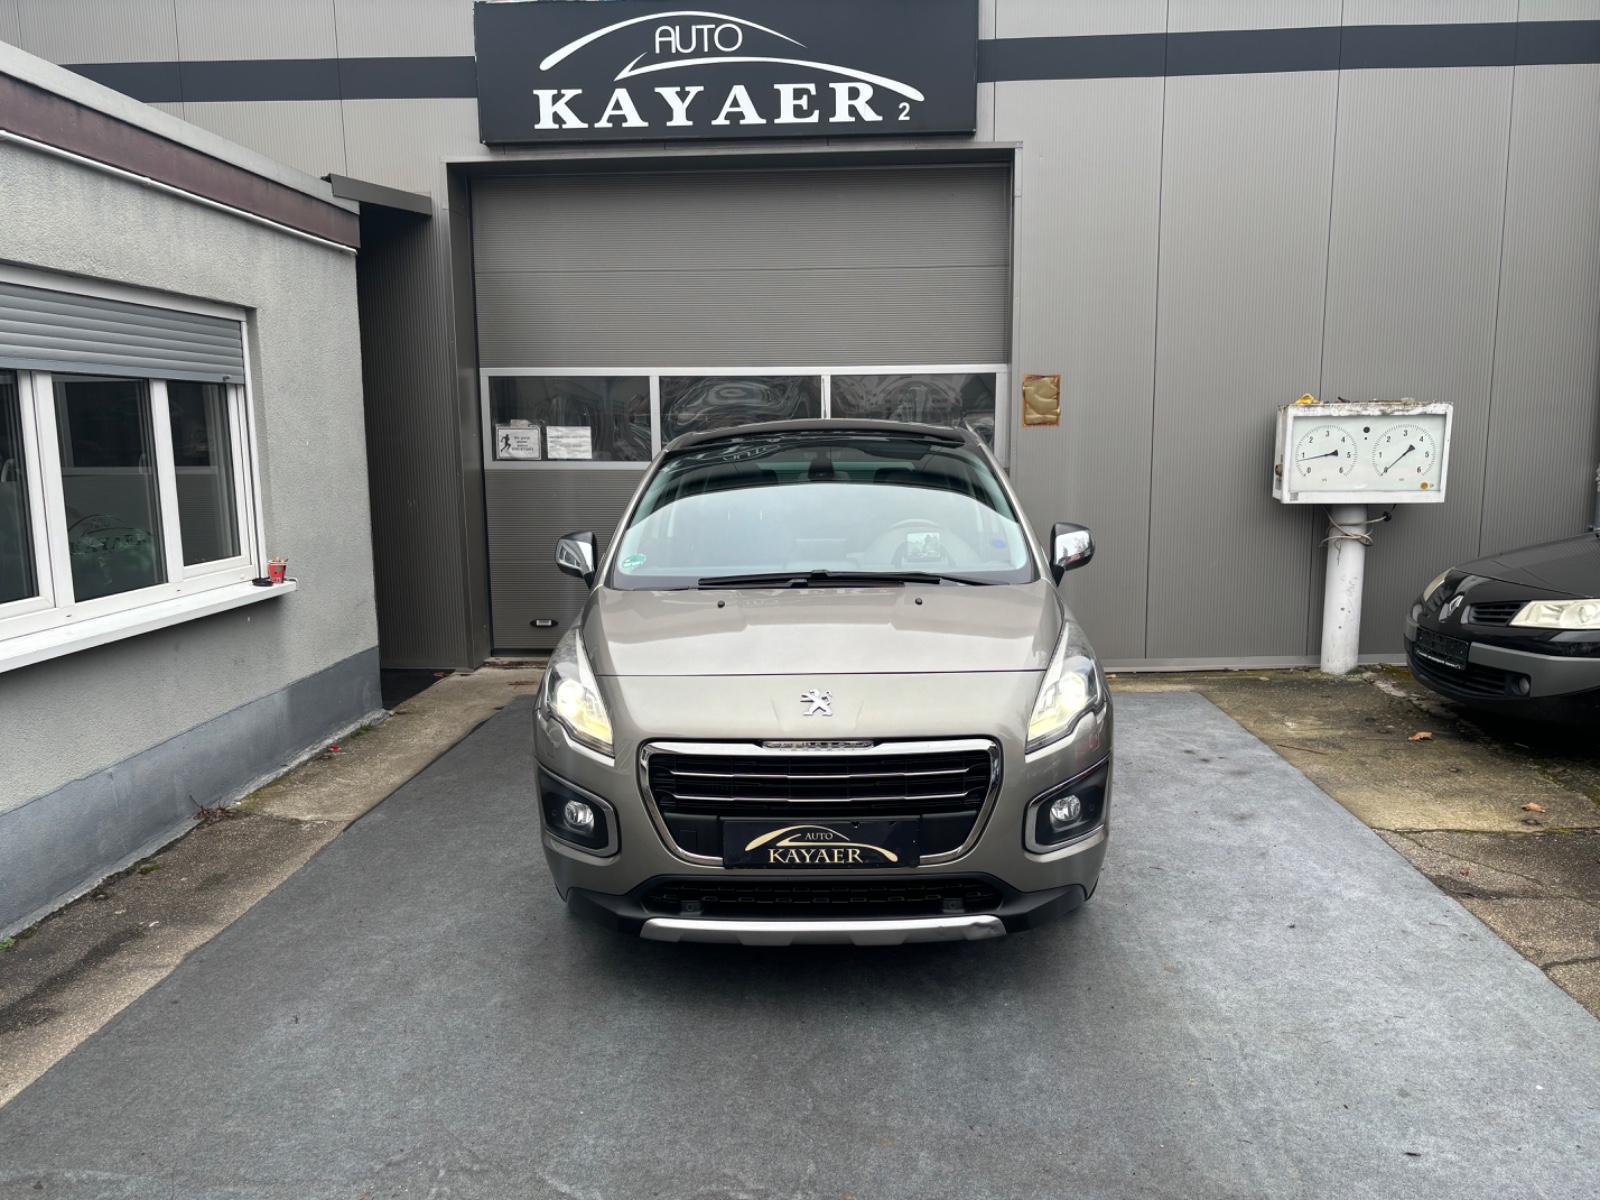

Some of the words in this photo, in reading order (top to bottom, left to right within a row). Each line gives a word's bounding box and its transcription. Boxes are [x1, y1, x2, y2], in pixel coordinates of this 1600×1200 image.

[655, 24, 743, 54] AUTO
[533, 82, 883, 130] KAYAER
[898, 102, 911, 121] 2
[805, 832, 834, 841] AUTO
[768, 848, 863, 864] KAYAER
